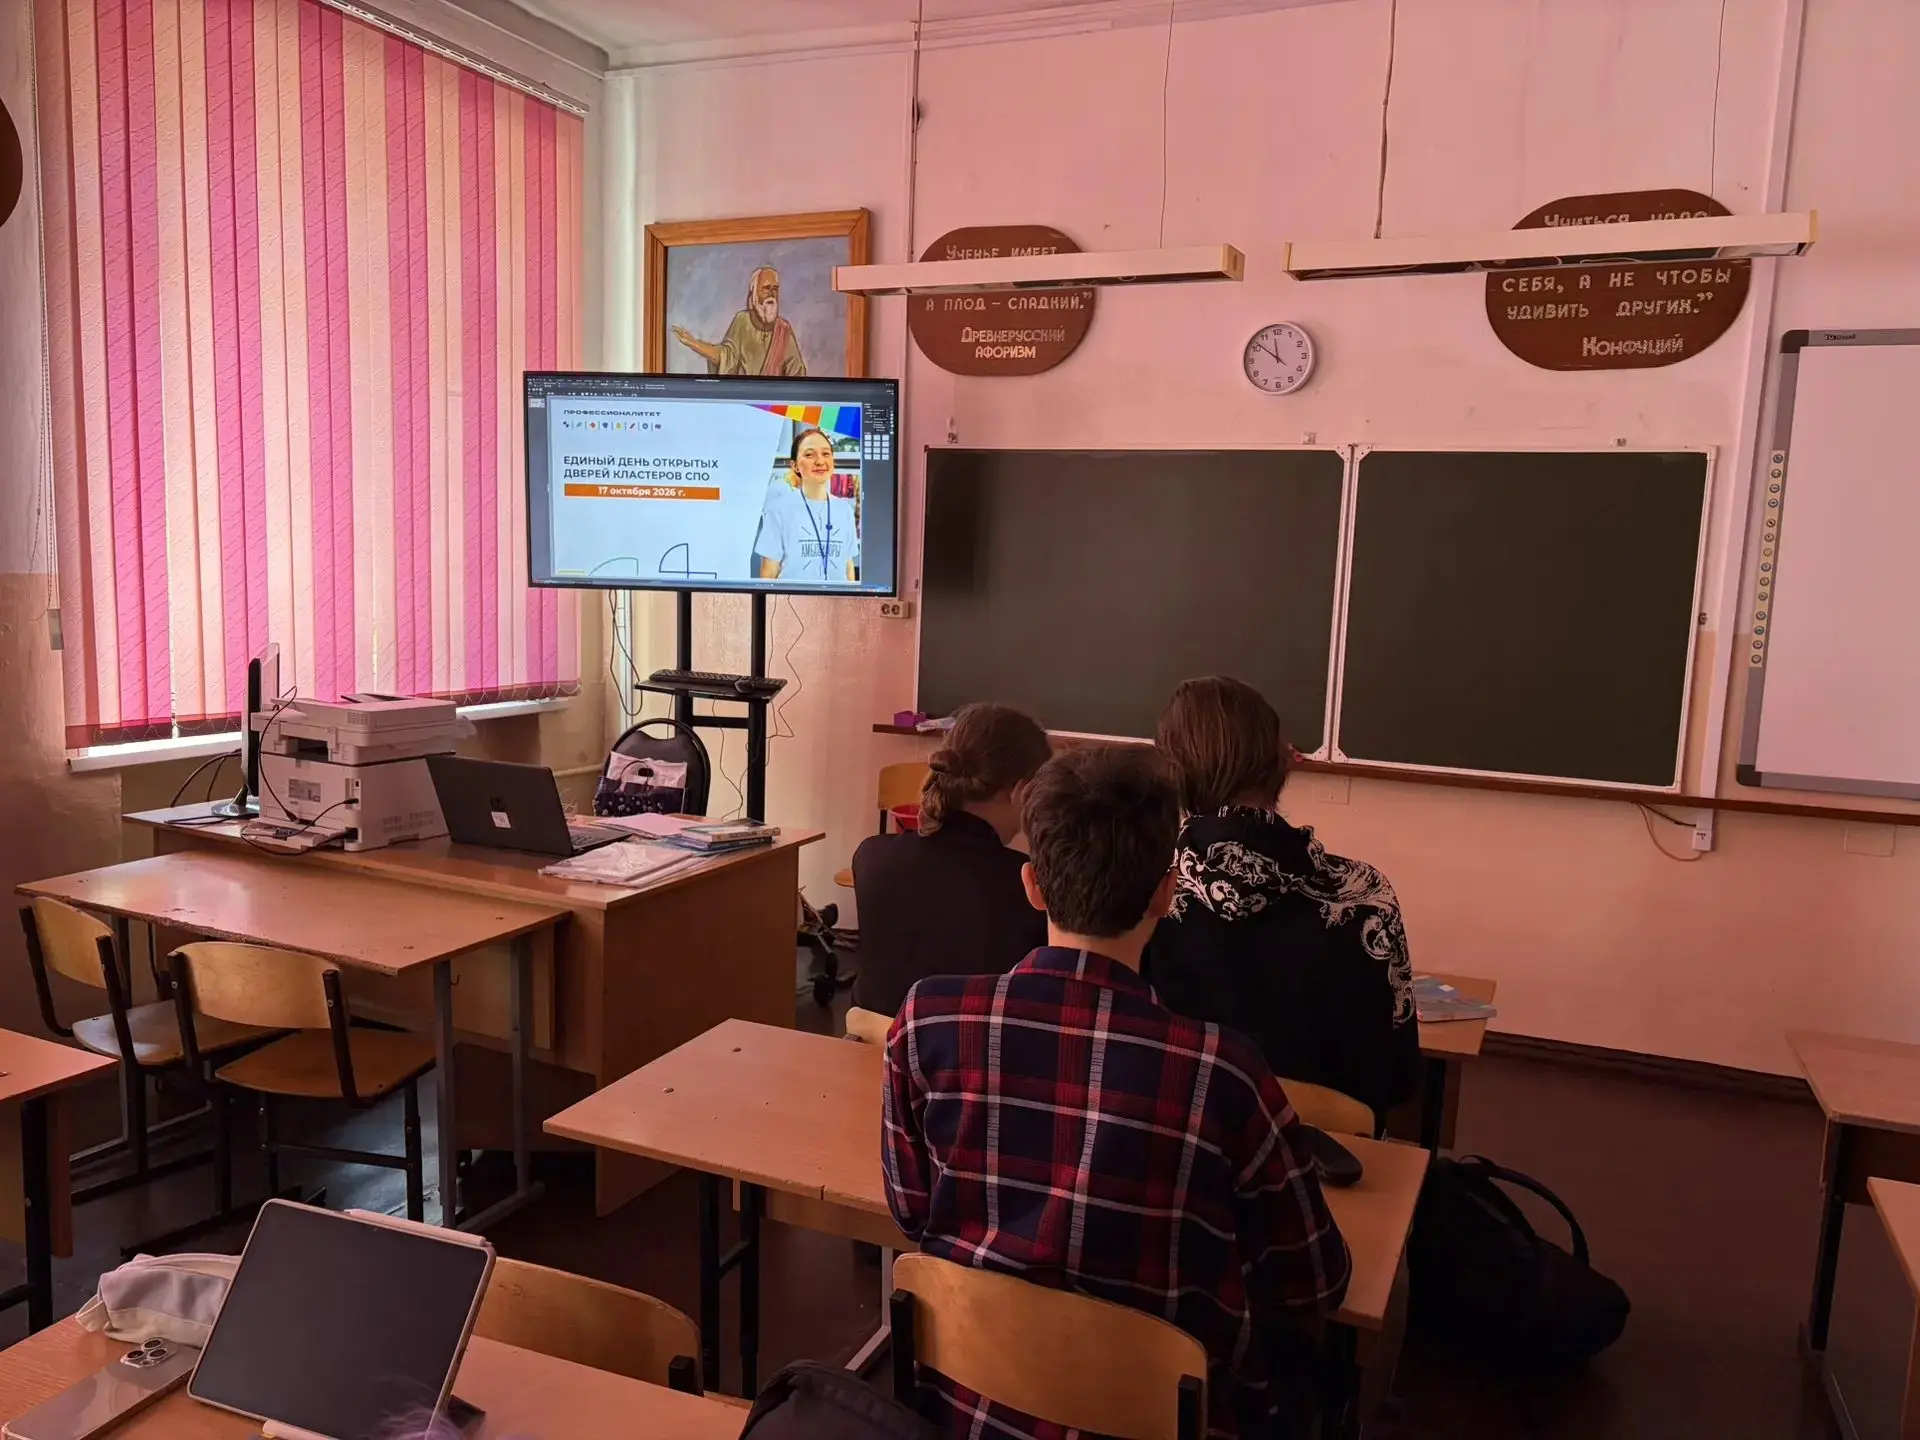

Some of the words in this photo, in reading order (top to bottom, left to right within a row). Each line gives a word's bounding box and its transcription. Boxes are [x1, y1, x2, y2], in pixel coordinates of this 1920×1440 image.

[1502, 276, 1564, 293] СЕБЯ,
[1578, 274, 1591, 290] А
[1609, 272, 1635, 287] НЕ
[1656, 268, 1731, 286] ЧТОБЫ
[925, 298, 935, 311] А
[944, 298, 986, 311] ПЛОД
[1507, 303, 1590, 320] УДИВИТЬ
[1273, 328, 1282, 336] 12
[975, 345, 1037, 359] АФОРИЗМ
[563, 409, 662, 417] ПРОФЕССИОНАЛИТЕТ
[564, 455, 615, 467] ЕДИНЫЙ
[618, 457, 650, 468] ДЕНЬ
[652, 457, 719, 469] ОТКРЫТЫХ
[564, 468, 610, 479] ДВЕРЕЙ
[613, 470, 682, 481] КЛАСТЕРОВ
[685, 471, 710, 481] СПО
[597, 485, 608, 495] 17
[609, 486, 651, 498] октября
[652, 487, 676, 496] 2026
[678, 489, 686, 497] г.
